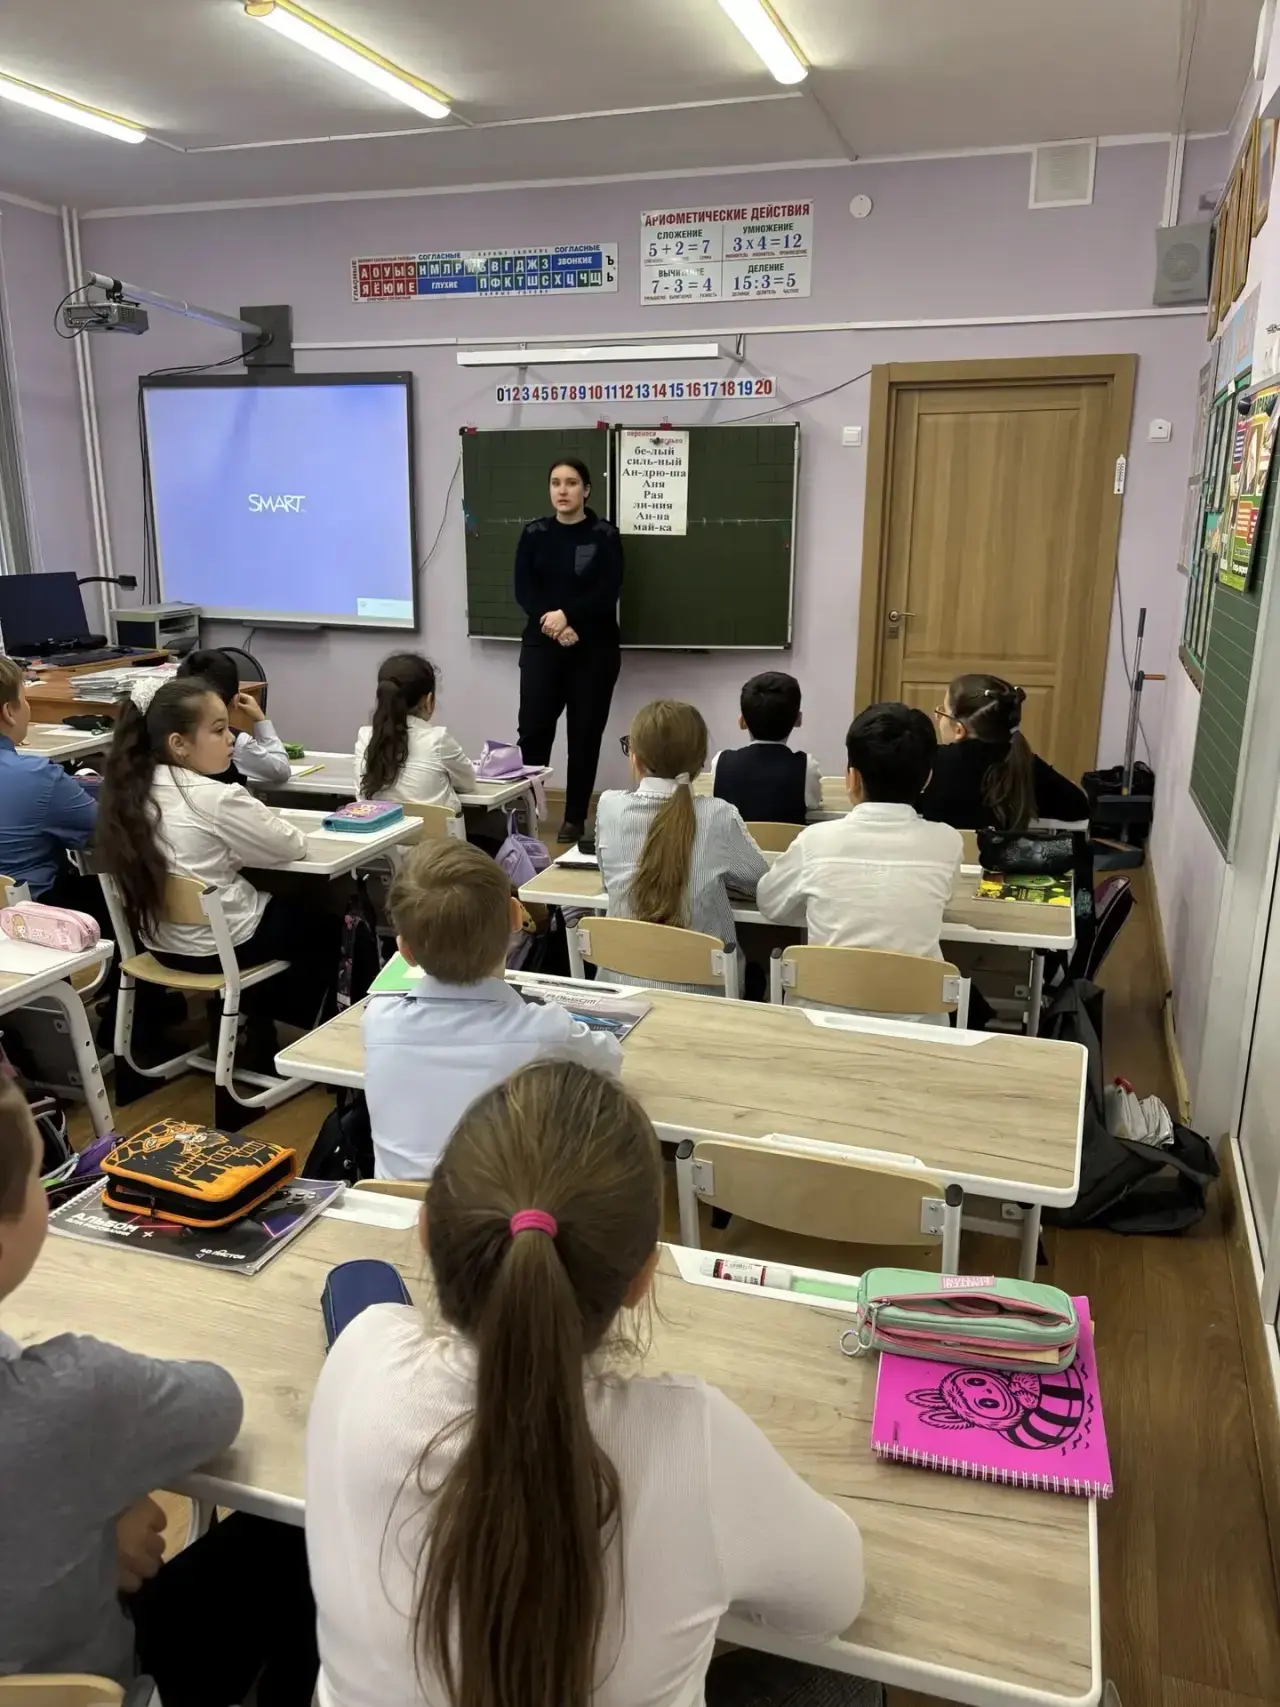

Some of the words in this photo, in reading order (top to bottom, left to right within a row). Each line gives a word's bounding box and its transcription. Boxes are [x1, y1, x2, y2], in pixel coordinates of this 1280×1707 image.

[645, 208, 747, 226] АРИФМЕТИЧЕСКИЕ
[751, 204, 810, 222] ДЕЙСТВИЯ
[743, 223, 794, 234] УМНОЖЕНИЕ
[657, 229, 703, 240] СЛОЖЕНИЕ
[555, 245, 600, 253] СОГЛАСНЫЕ
[557, 257, 592, 266] ЗВОНКИЕ
[361, 268, 368, 278] А
[384, 267, 391, 277] У
[395, 266, 404, 276] Ы
[419, 265, 426, 275] Н
[430, 264, 439, 274] М
[443, 264, 451, 274] Л
[455, 263, 461, 273] Р
[492, 263, 498, 272] В
[504, 261, 510, 271] Г
[516, 260, 524, 272] Д
[528, 259, 537, 270] Ж
[748, 263, 784, 273] ДЕЛЕНИЕ
[480, 278, 487, 288] П
[491, 277, 501, 288] Ф
[504, 277, 512, 287] К
[517, 276, 524, 287] Т
[528, 275, 538, 285] Ш
[554, 274, 562, 285] Х
[567, 274, 575, 286] Ц
[580, 273, 587, 284] Ч
[590, 272, 602, 284] Щ
[362, 286, 369, 294] Я
[384, 283, 393, 293] Ю
[397, 283, 404, 293] И
[409, 282, 415, 292] Е
[432, 281, 458, 290] ГЛУХИЕ
[635, 446, 674, 455] бе-лый
[622, 468, 686, 478] Ан-дрю-ша
[643, 480, 665, 488] Аня
[644, 491, 664, 499] Рая
[248, 493, 306, 513] SMART
[637, 512, 669, 520] Ан-на
[633, 523, 672, 531] май-ка
[72, 1212, 139, 1232] АЛЬБОМ
